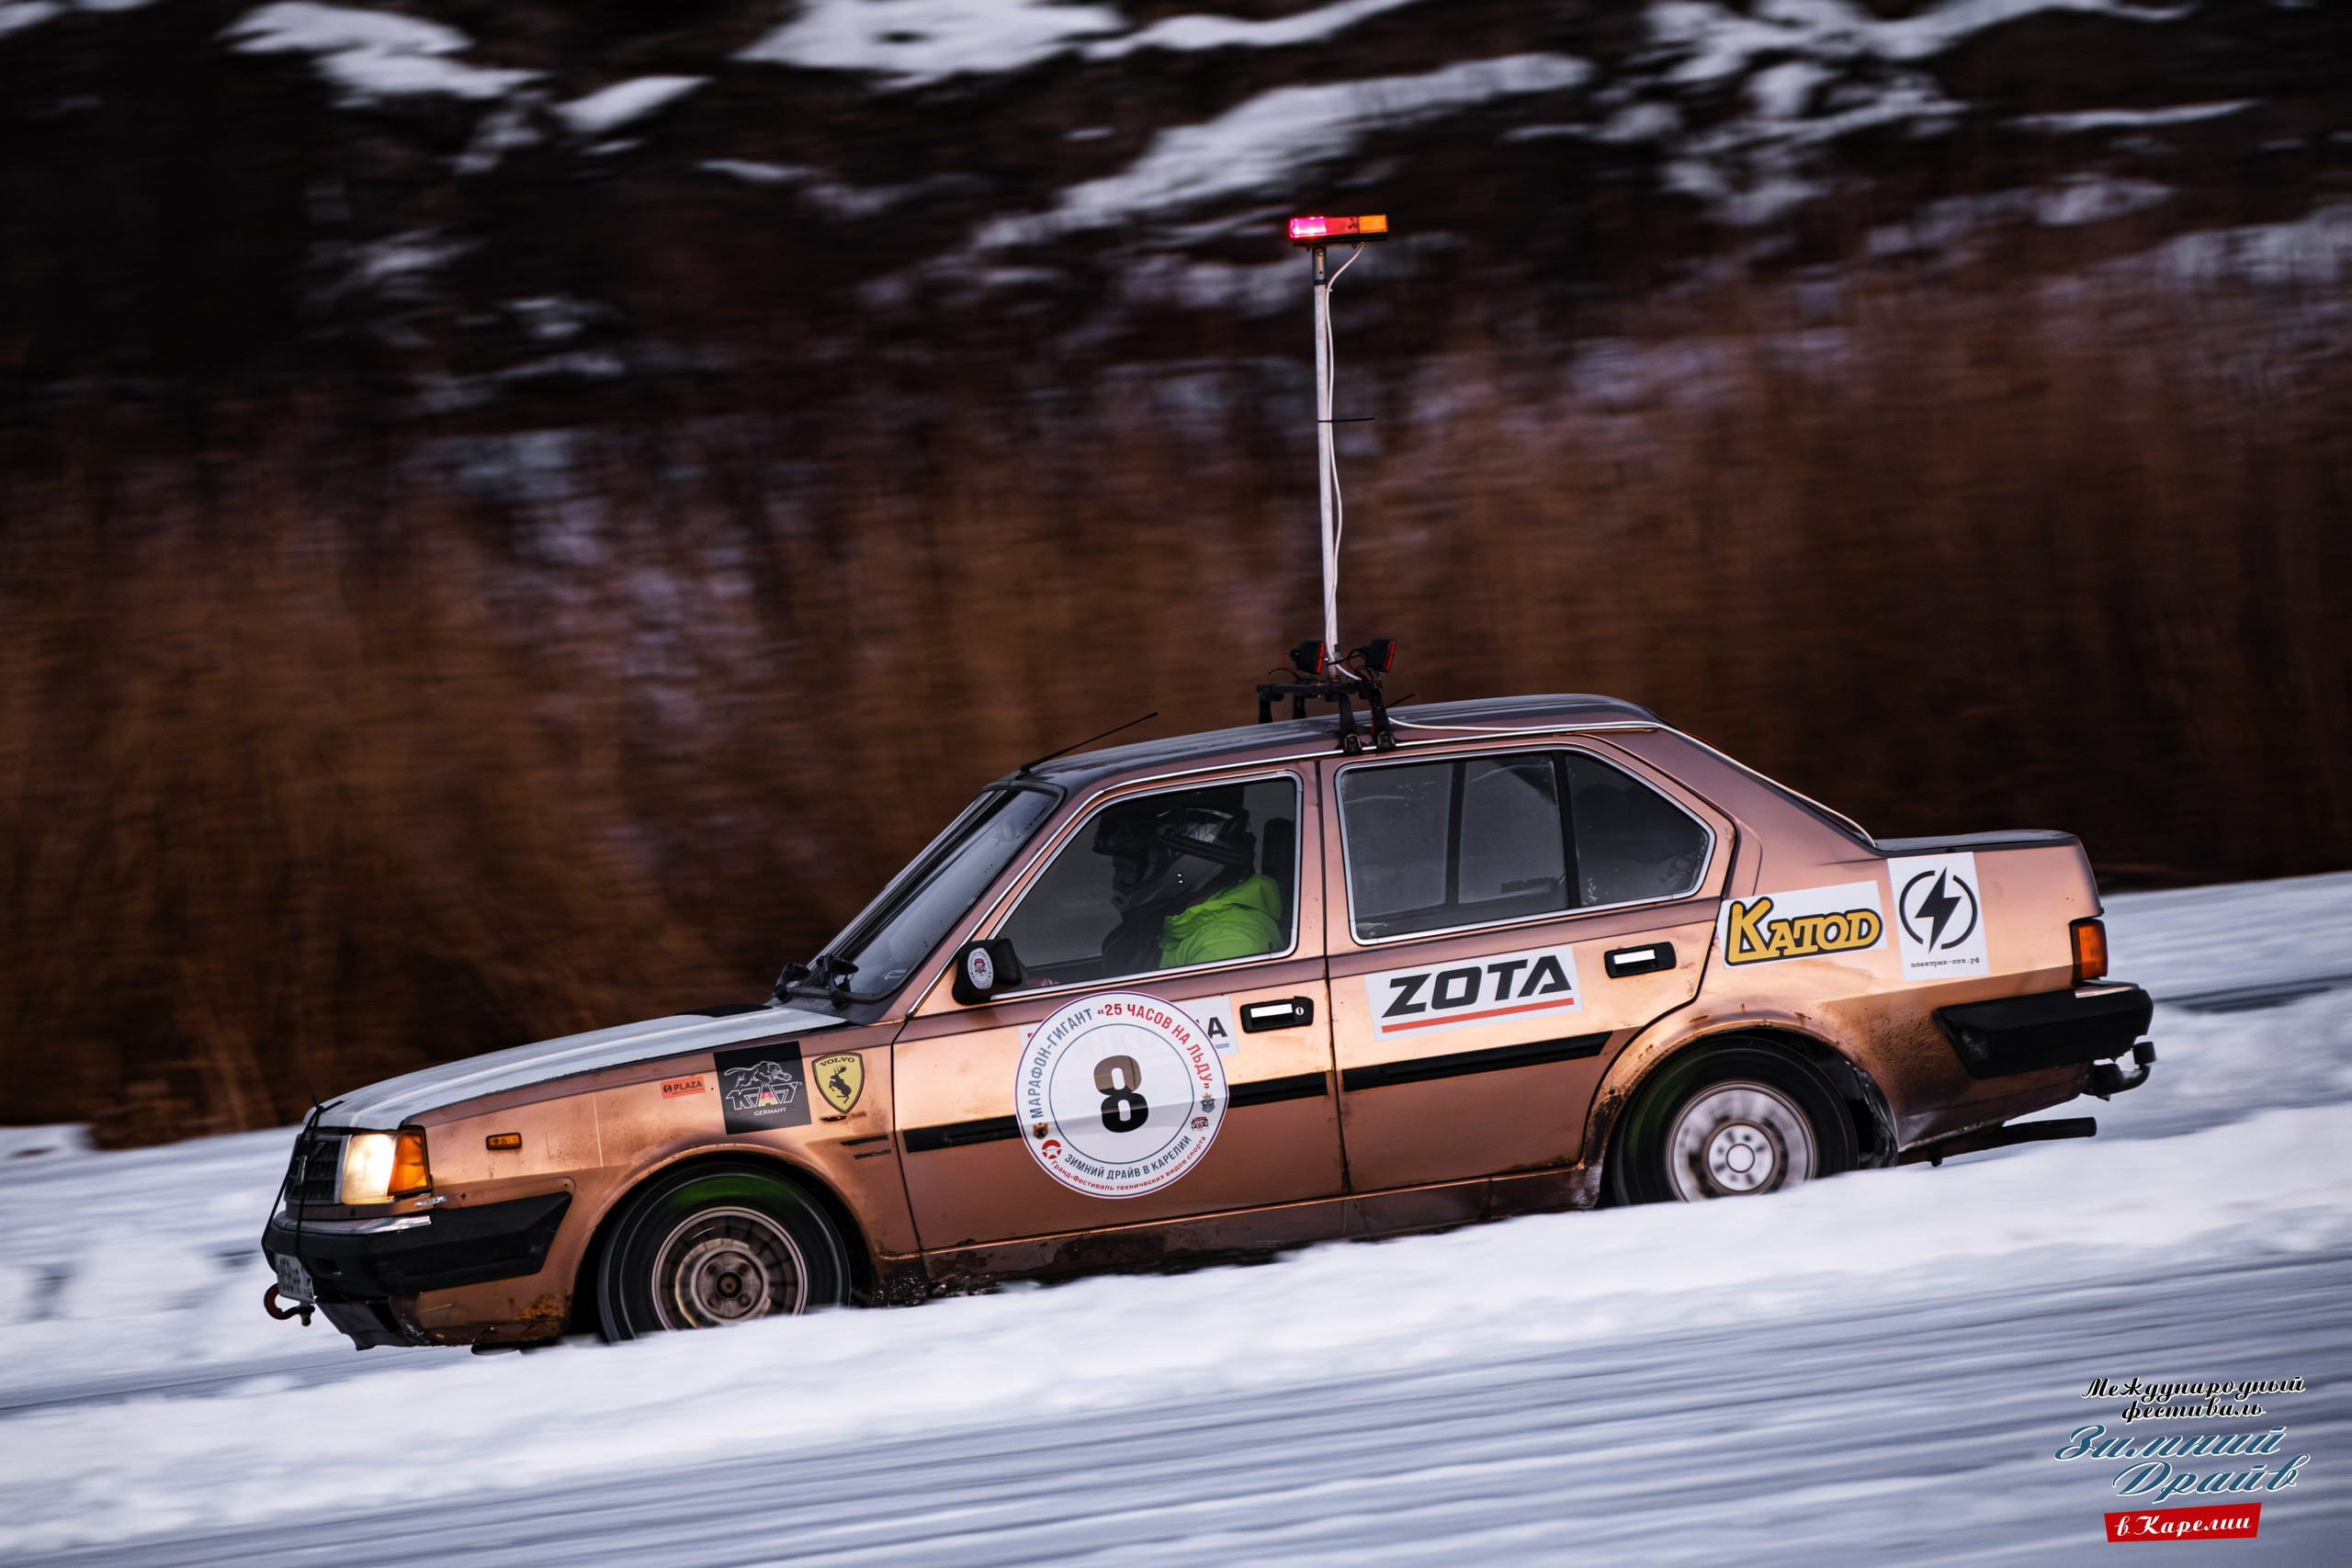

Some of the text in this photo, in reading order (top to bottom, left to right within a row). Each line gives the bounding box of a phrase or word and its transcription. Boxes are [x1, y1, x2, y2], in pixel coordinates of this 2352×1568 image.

[1724, 896, 1883, 965] KATOD
[1381, 954, 1572, 1019] ZOTA
[673, 1080, 703, 1091] PLAZA
[820, 1056, 855, 1066] VOLVO
[1028, 1008, 1093, 1119] МАРАФОН-ГИГАНТ
[1097, 1003, 1123, 1016] «25
[1126, 1003, 1173, 1030] ЧАСОВ
[1171, 1024, 1193, 1045] НА
[1186, 1043, 1214, 1090] ЛЬДУ»
[753, 1107, 787, 1116] GERMANY
[1093, 1055, 1148, 1134] 8
[1051, 1135, 1206, 1191] Гранд-Фестиваль технических видов спорта
[1064, 1135, 1193, 1180] ЗИМНИЙ ДРАЙВ В КАРЕЛИИ
